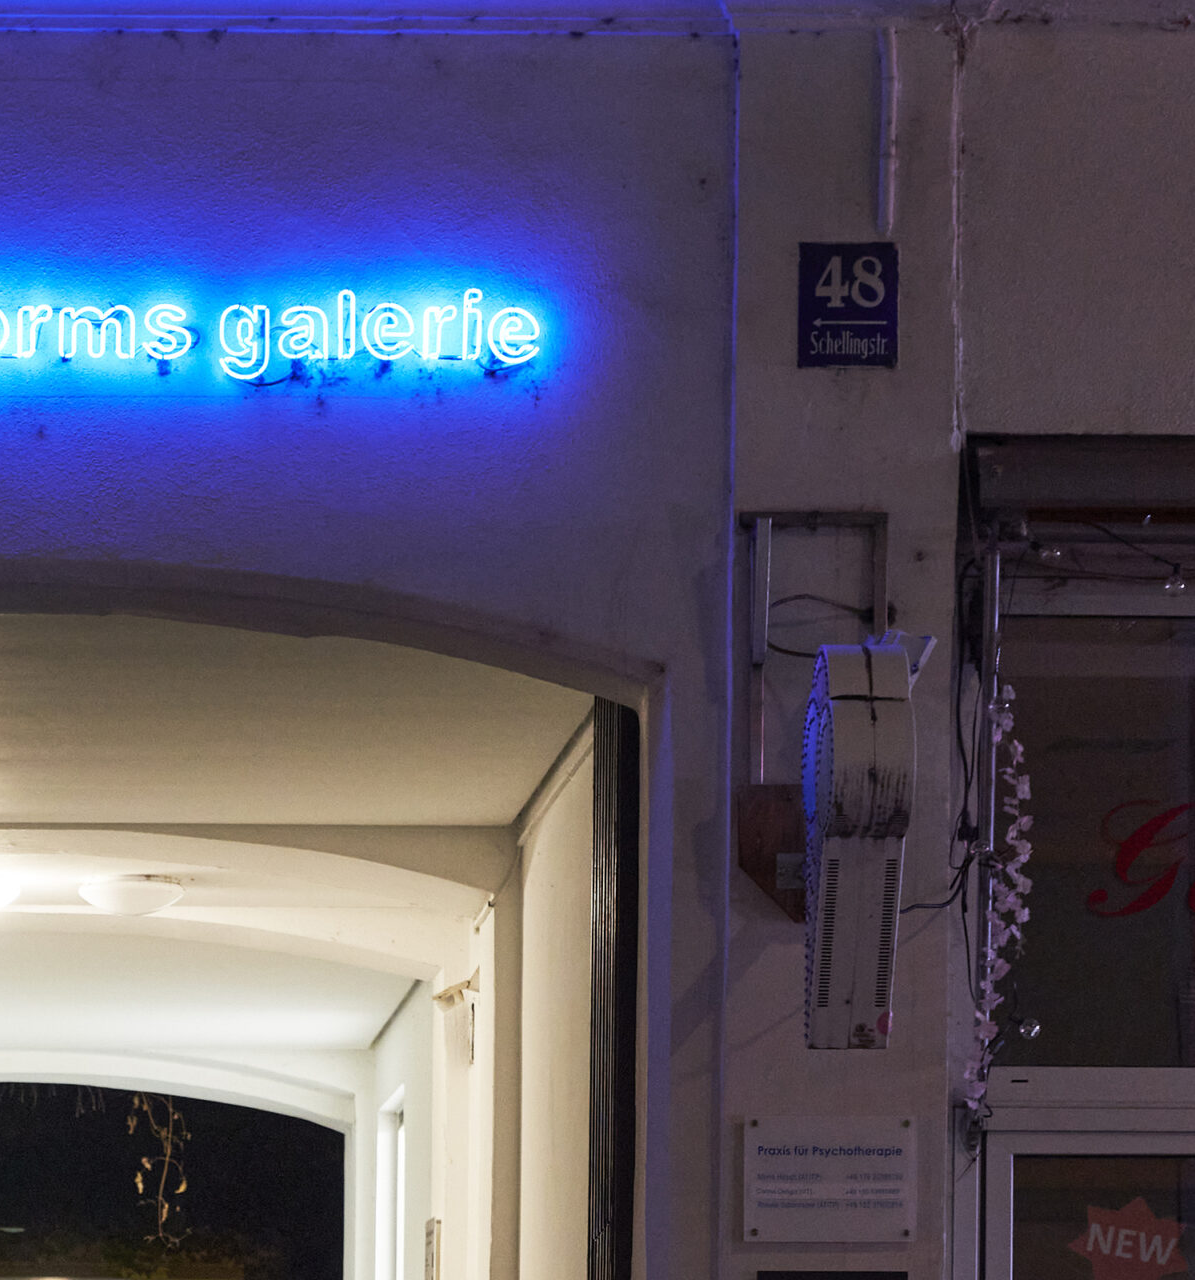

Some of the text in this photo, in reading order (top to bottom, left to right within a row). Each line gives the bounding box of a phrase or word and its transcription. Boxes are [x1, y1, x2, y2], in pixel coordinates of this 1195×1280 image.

[815, 255, 886, 308] 48
[219, 288, 540, 380] galerie
[809, 330, 889, 359] Schellingstr.
[757, 1145, 791, 1156] Praxis
[812, 1145, 903, 1158] Psychotherapie
[1087, 1223, 1178, 1265] NEW
